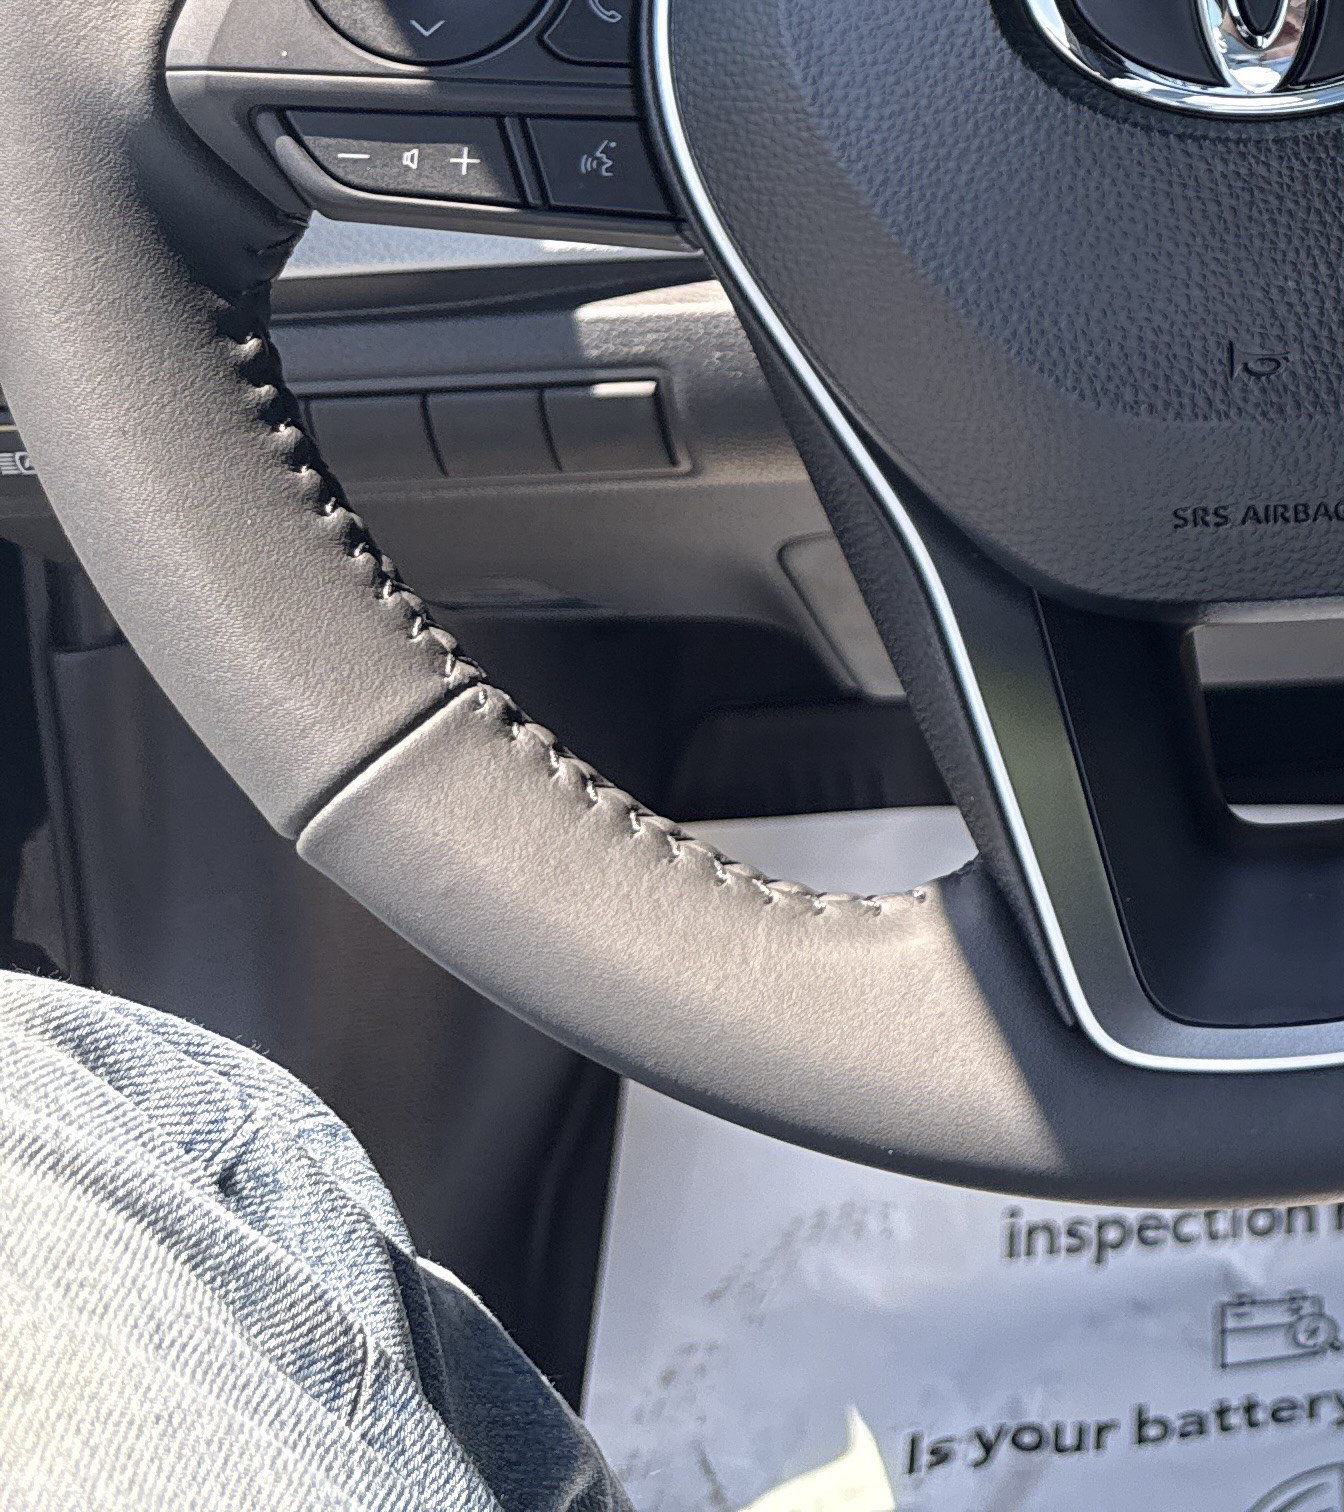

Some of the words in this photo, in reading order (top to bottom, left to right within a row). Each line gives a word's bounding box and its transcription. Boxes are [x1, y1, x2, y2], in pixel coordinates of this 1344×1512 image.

[1171, 504, 1230, 530] SRS
[1004, 1202, 1316, 1266] inspection
[903, 1429, 953, 1476] Is
[968, 1417, 1119, 1470] your
